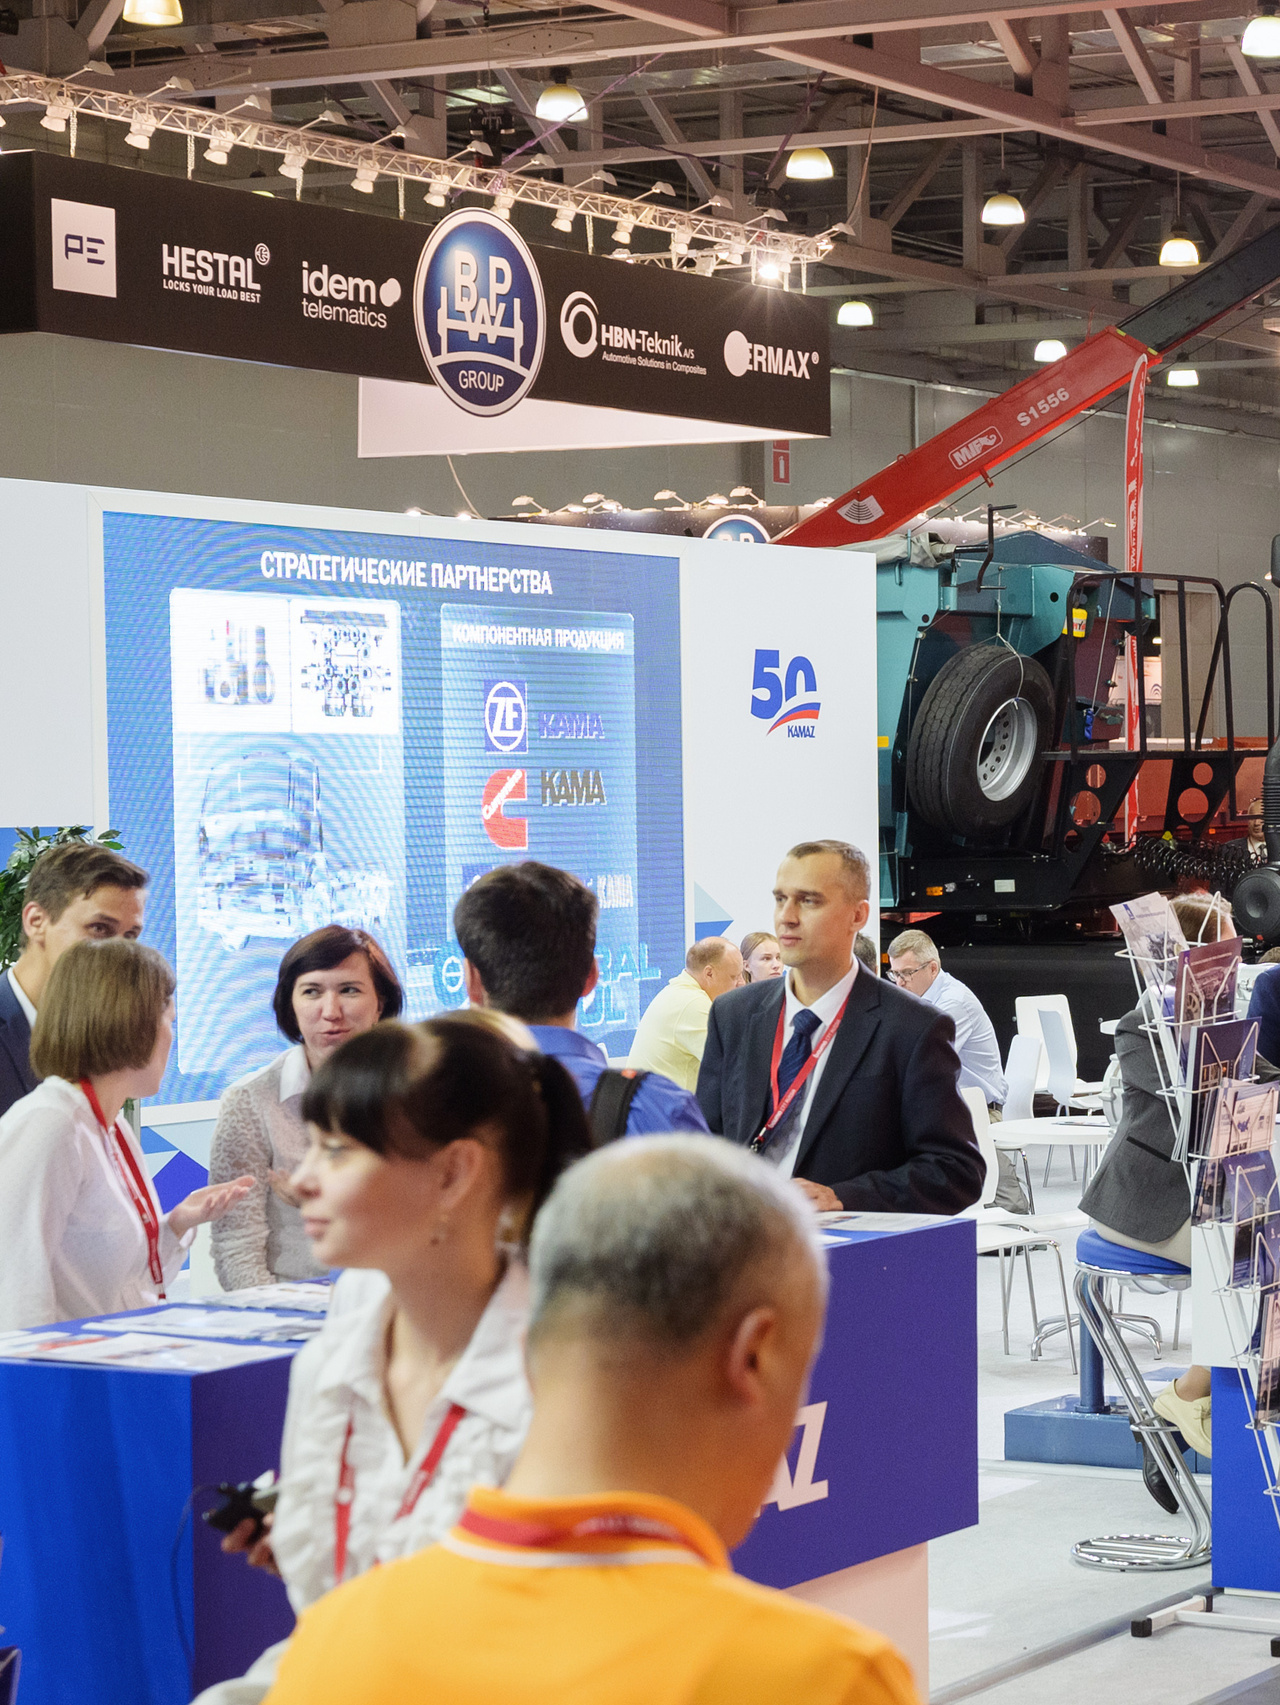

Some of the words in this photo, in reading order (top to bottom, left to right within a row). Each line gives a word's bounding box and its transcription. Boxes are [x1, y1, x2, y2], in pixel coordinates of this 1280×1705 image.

[162, 243, 261, 291] HESTAL
[302, 260, 377, 305] idem
[163, 278, 191, 293] LOCKS
[192, 283, 215, 297] YOUR
[216, 287, 238, 300] LOAD
[240, 291, 261, 304] BEST
[302, 298, 388, 329] telematics
[601, 323, 683, 358] HBN-Teknik
[602, 350, 637, 366] Automotive
[637, 355, 665, 370] Solutions
[665, 360, 672, 371] in
[672, 361, 707, 376] Composites
[458, 369, 505, 393] GROUP
[1017, 387, 1070, 427] S1556
[260, 550, 428, 588] СТРАТЕГИЧЕСКИЕ
[431, 562, 553, 595] ПАРТНЕРСТВА
[453, 624, 552, 647] КОМПОНЕНТНАЯ
[555, 628, 625, 651] ПРОДУКЦИЯ
[751, 649, 817, 720] 50
[787, 725, 816, 739] KAMAZ
